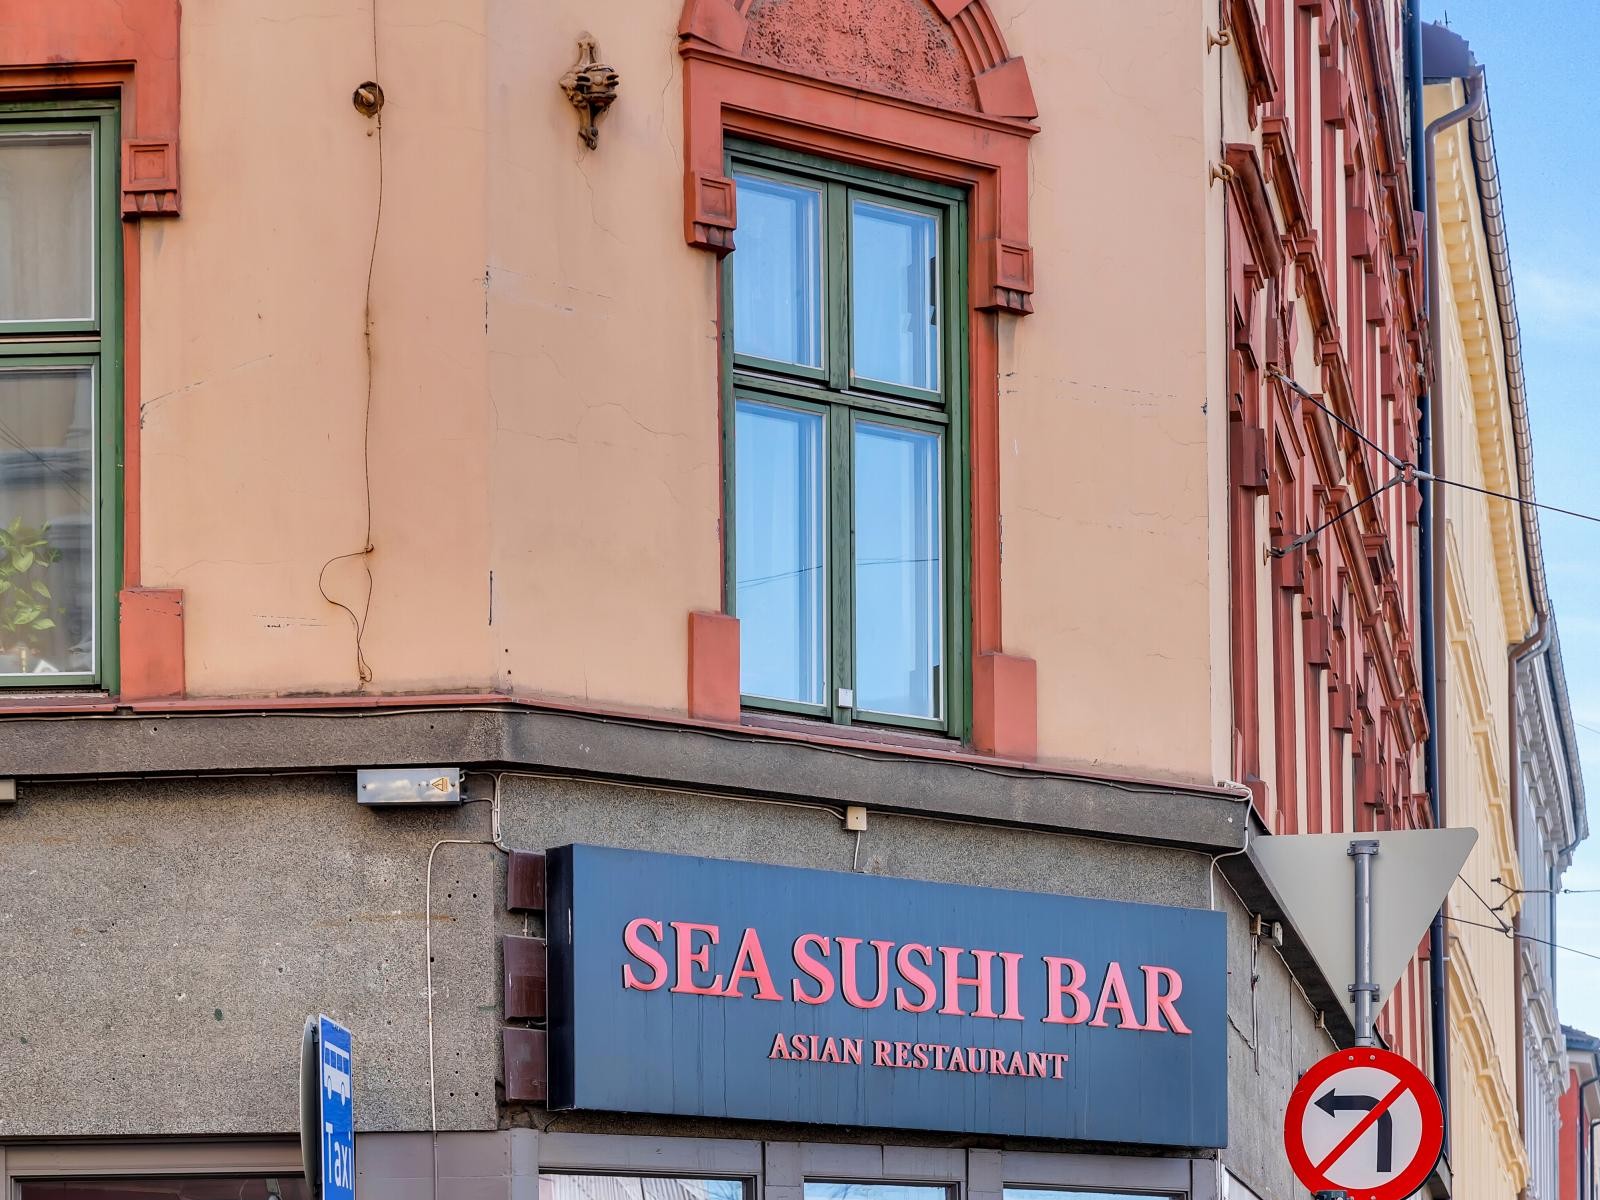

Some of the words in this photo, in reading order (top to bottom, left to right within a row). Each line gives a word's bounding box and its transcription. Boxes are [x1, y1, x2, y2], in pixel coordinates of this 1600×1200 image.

[621, 917, 784, 1001] SEA
[792, 933, 1025, 1021] SUSHI
[1041, 956, 1193, 1035] BAR
[768, 1032, 864, 1065] ASIAN
[872, 1039, 1069, 1079] RESTAURANT
[325, 1121, 353, 1191] Taxi
